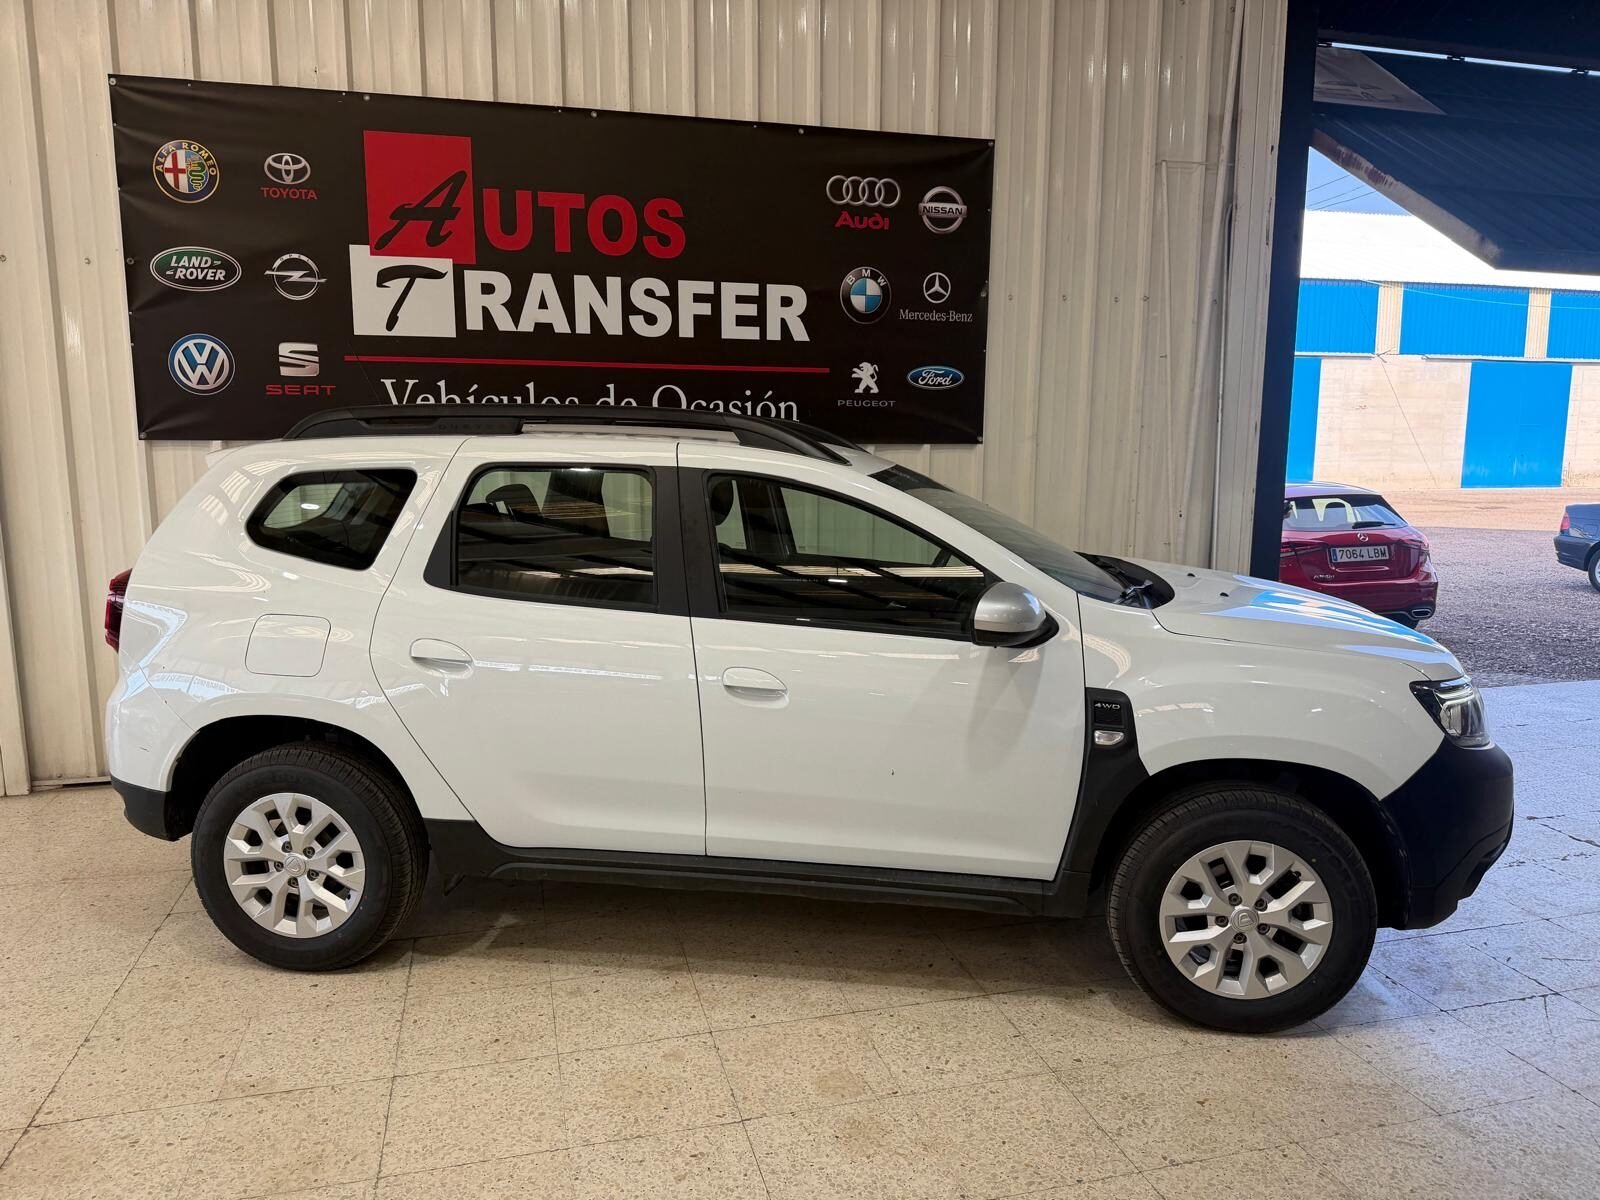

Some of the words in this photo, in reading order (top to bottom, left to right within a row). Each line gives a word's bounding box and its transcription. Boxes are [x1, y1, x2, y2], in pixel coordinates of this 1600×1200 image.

[155, 142, 176, 172] ALFA
[182, 142, 217, 176] ROMEO
[261, 187, 318, 200] TOYOTA
[922, 205, 963, 216] NISSAN
[834, 211, 889, 230] Audi
[846, 268, 887, 287] BMW
[376, 264, 810, 342] TRANSFER
[899, 308, 973, 323] Mercedes-Benz
[918, 368, 953, 386] Ford
[265, 384, 337, 396] SEAT
[837, 400, 897, 408] PEUGEOT
[1338, 549, 1364, 560] 7064
[1367, 547, 1387, 559] LBM
